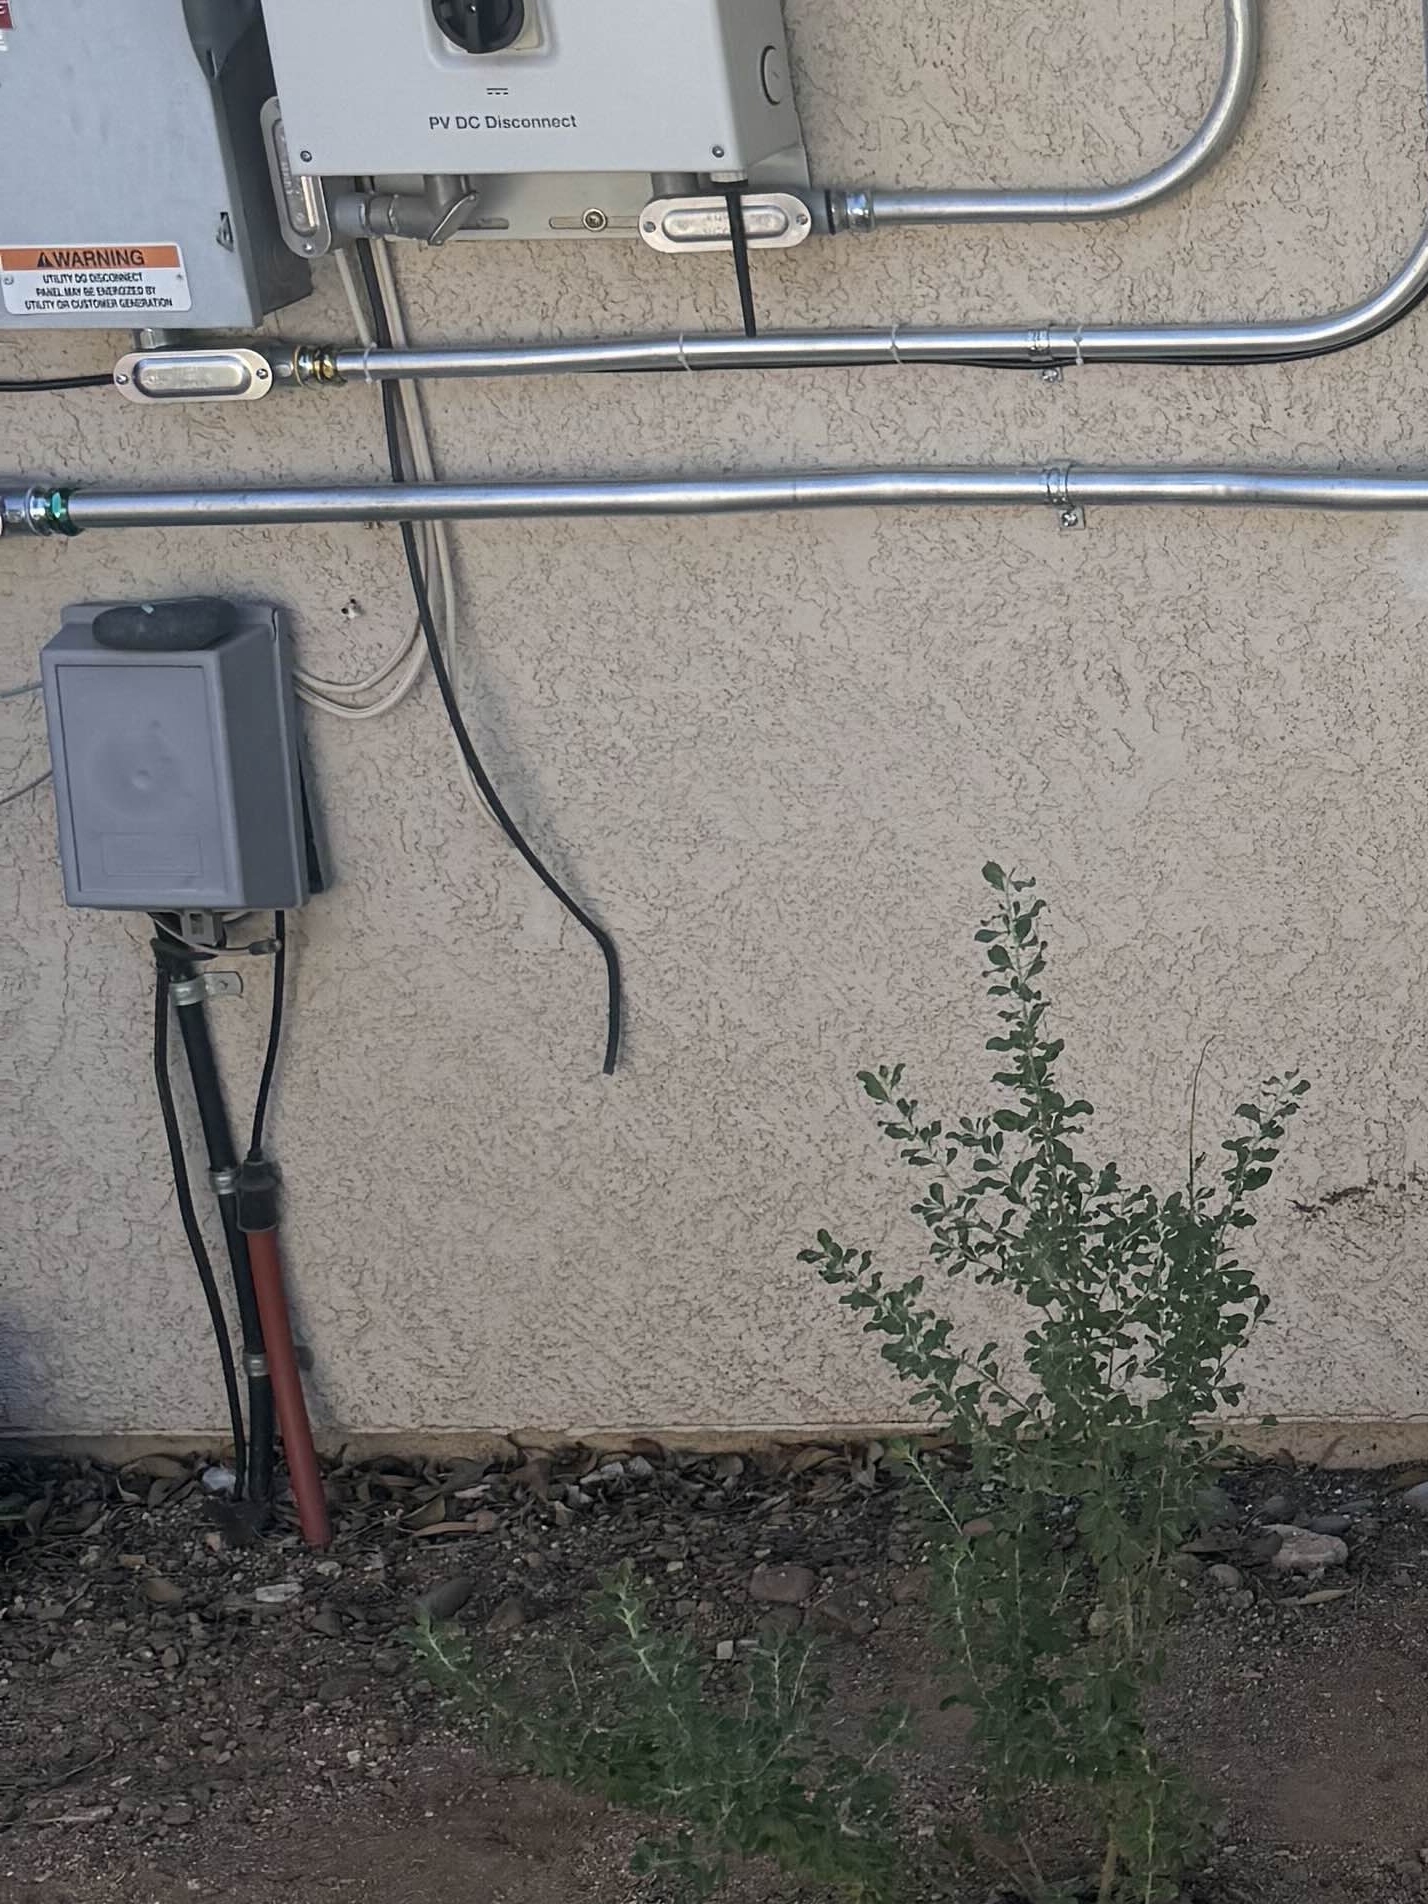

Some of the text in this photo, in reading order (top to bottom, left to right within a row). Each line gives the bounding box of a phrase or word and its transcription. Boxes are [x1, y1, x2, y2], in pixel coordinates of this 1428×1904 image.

[429, 114, 578, 130] PV DC Disconnect
[53, 249, 145, 268] WARNING
[43, 274, 74, 284] UTILITY
[89, 272, 143, 283] DISCONNECT
[36, 286, 157, 298] PANEL MAY BE ENERGIZED BY
[25, 297, 173, 311] UTILITY OR CUSTOMER GENERATION
